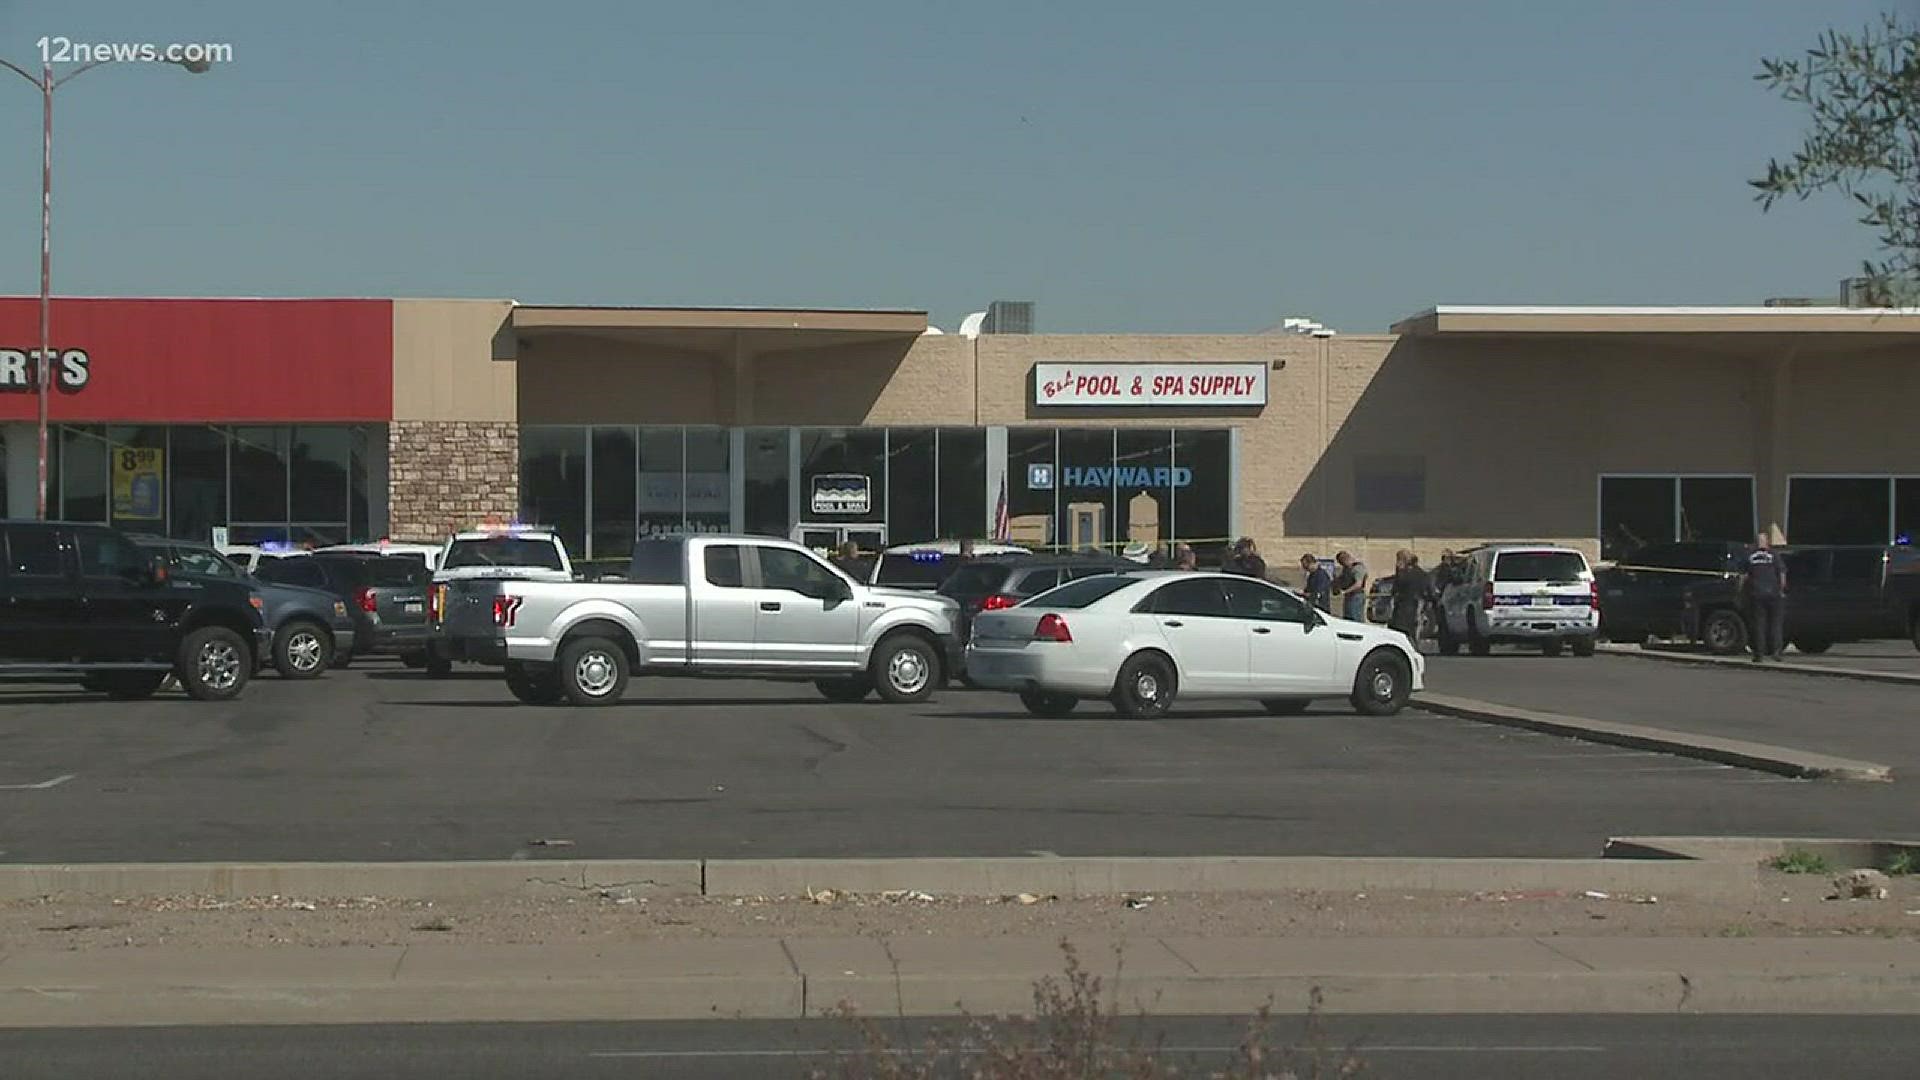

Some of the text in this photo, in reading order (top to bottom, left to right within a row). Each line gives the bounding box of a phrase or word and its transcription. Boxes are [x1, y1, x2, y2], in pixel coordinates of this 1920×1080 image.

[0, 350, 88, 386] RTS
[1075, 376, 1121, 396] POOL
[1131, 376, 1142, 395] &
[1152, 376, 1184, 396] SPA
[1189, 376, 1255, 396] SUPPLY
[1063, 466, 1193, 487] HAYWARD
